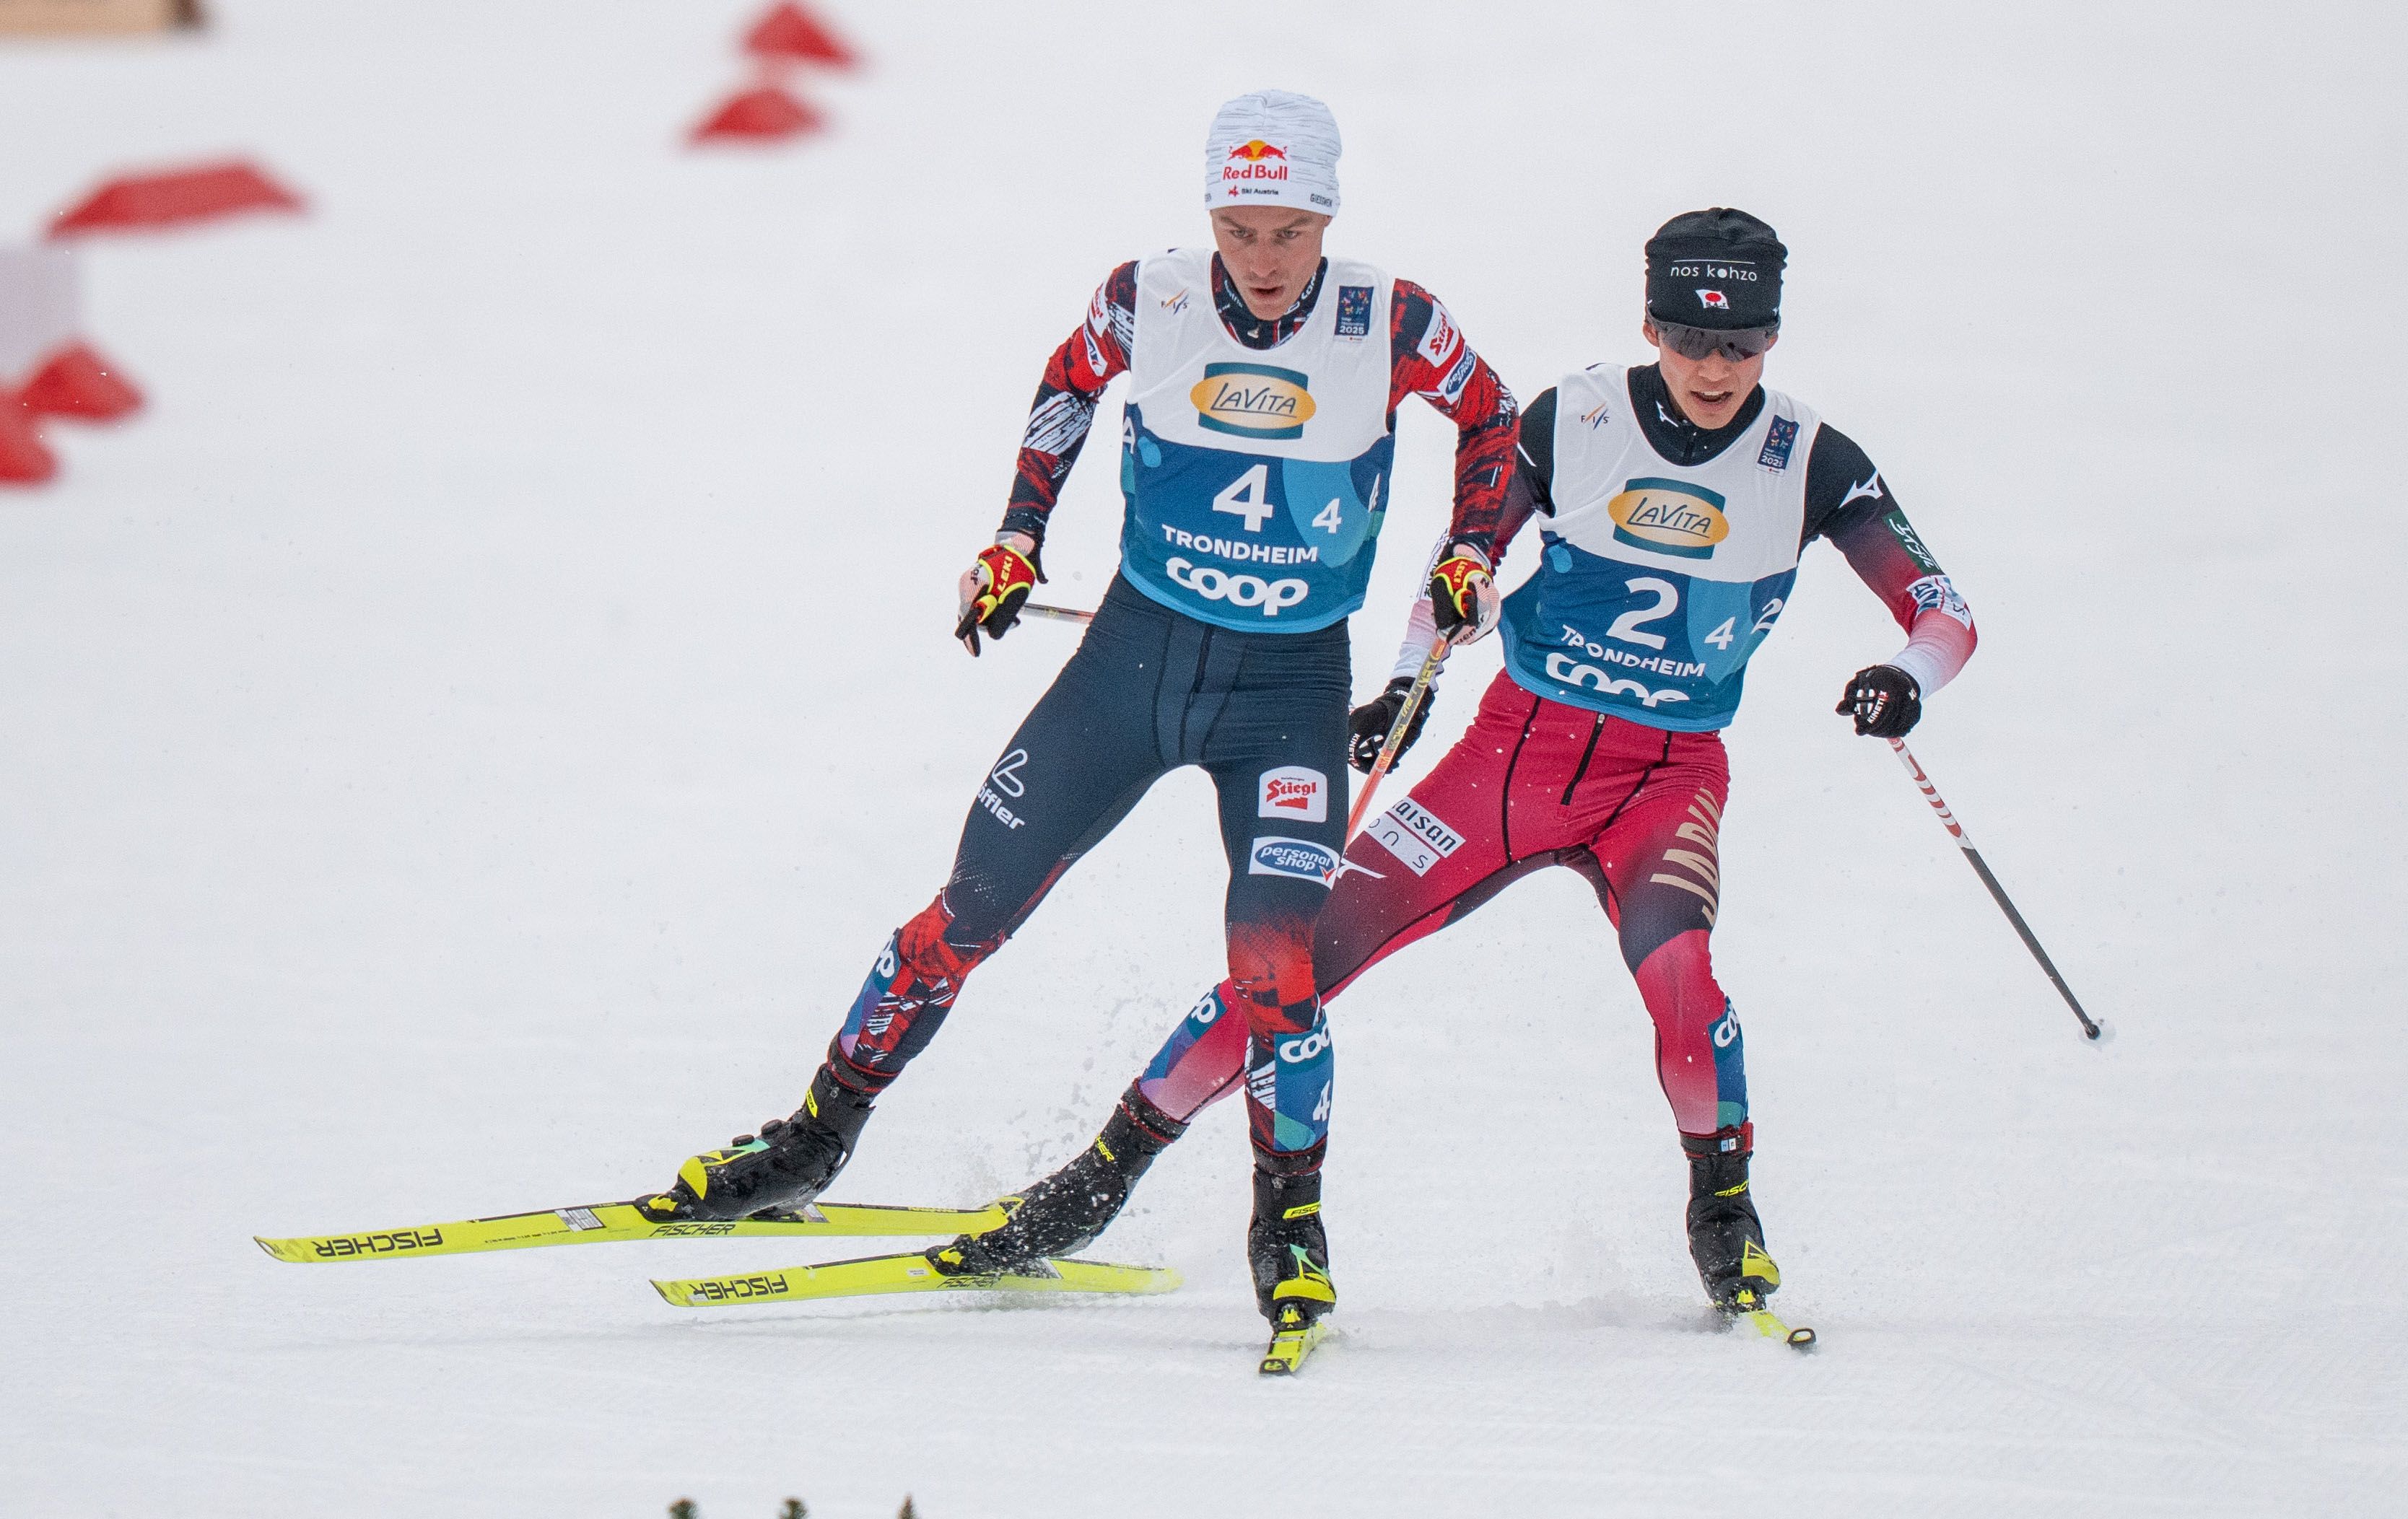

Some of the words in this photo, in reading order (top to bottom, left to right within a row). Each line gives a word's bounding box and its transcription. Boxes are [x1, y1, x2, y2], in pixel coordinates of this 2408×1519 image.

[1223, 165, 1252, 180] Red
[1255, 165, 1288, 180] Bull
[1670, 266, 1699, 276] nos
[1340, 325, 1364, 335] 2025
[1761, 455, 1784, 468] 2025
[1212, 464, 1273, 533] 4
[1312, 498, 1342, 534] 4
[1161, 523, 1318, 564] TRONDHEIM
[997, 555, 1013, 592] LEKI
[1166, 556, 1309, 616] coop
[1605, 577, 1679, 650] 2
[1750, 597, 1784, 635] 2
[1561, 623, 1706, 677] TRONDHEIM
[1704, 616, 1736, 650] 4
[1266, 779, 1317, 802] Stiegl
[1392, 800, 1457, 852] aisan
[1260, 846, 1330, 866] personal
[1275, 856, 1316, 872] shop
[1279, 1025, 1330, 1064] coo
[1312, 1080, 1330, 1121] 4
[1714, 1178, 1748, 1196] FISC
[312, 1228, 444, 1257] FISCHER
[650, 1223, 736, 1238] FISCHER
[688, 1274, 789, 1300] FISCHER
